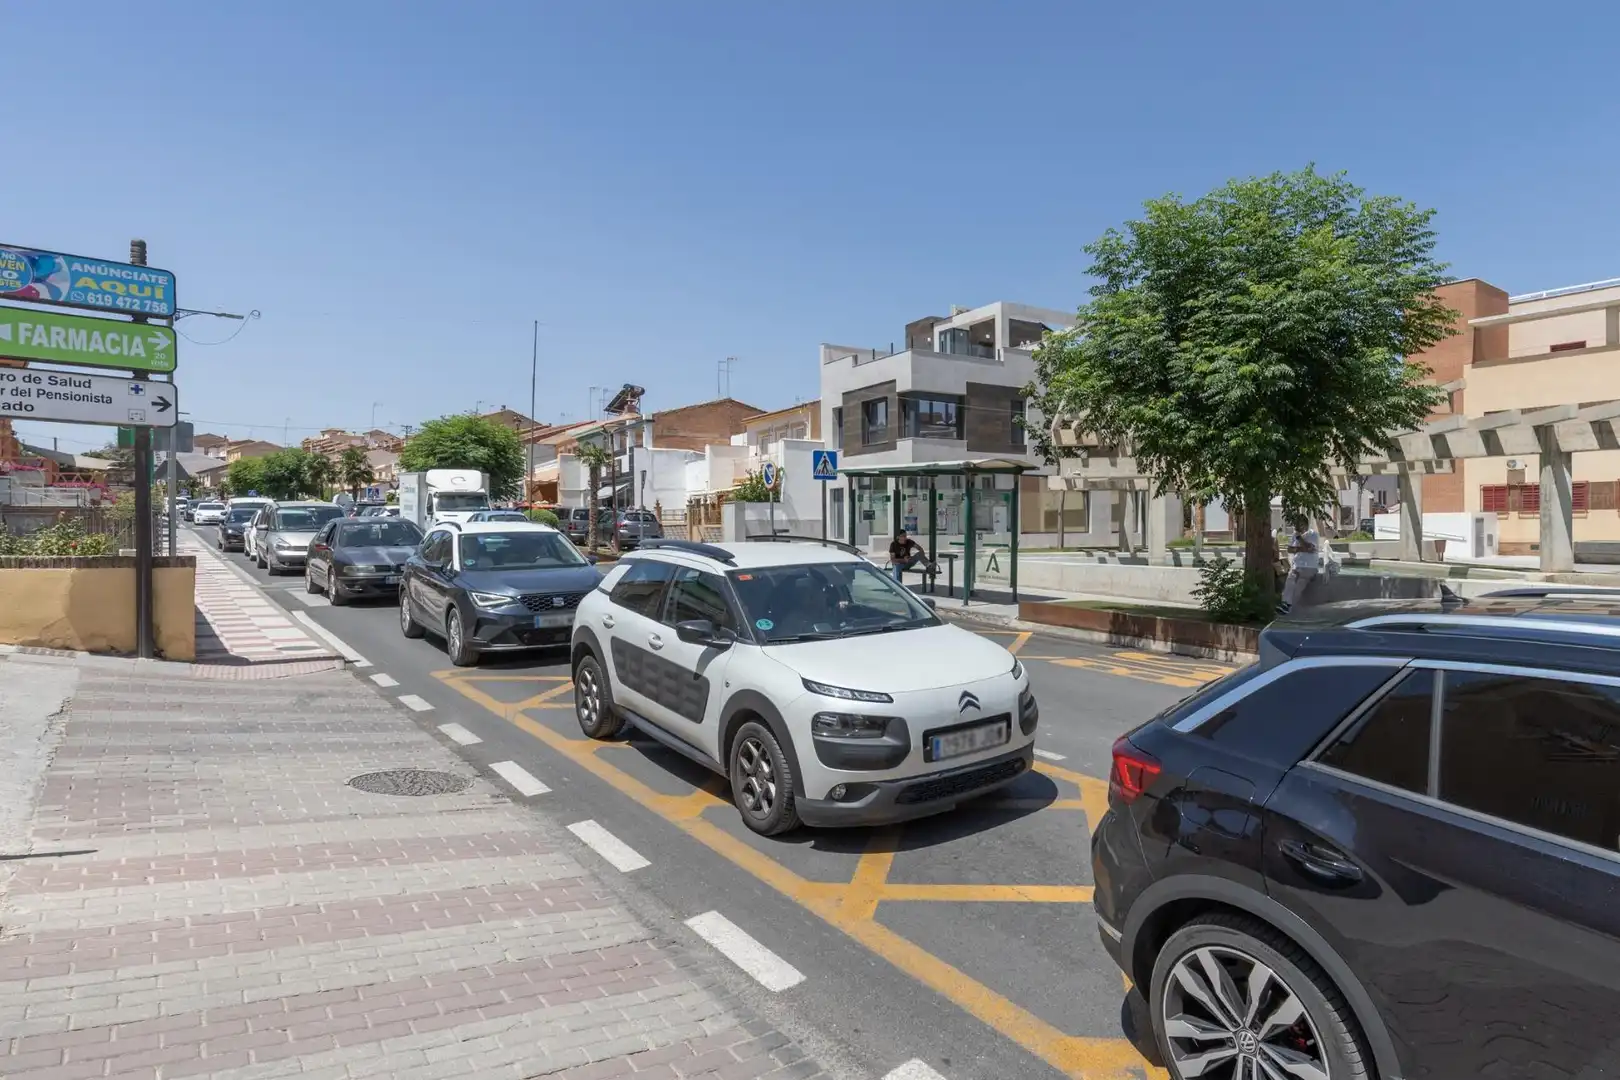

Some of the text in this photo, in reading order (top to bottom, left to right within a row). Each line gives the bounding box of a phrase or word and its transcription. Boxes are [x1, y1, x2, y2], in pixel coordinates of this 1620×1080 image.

[0, 270, 18, 279] O
[71, 262, 168, 284] ANÚNCIATE
[75, 276, 164, 299] AQUÍ
[87, 292, 168, 313] 619 472 758
[18, 322, 146, 357] FARMACIA
[22, 373, 42, 384] de
[48, 375, 92, 389] Salud
[10, 386, 31, 397] del
[36, 388, 113, 404] Pensionista
